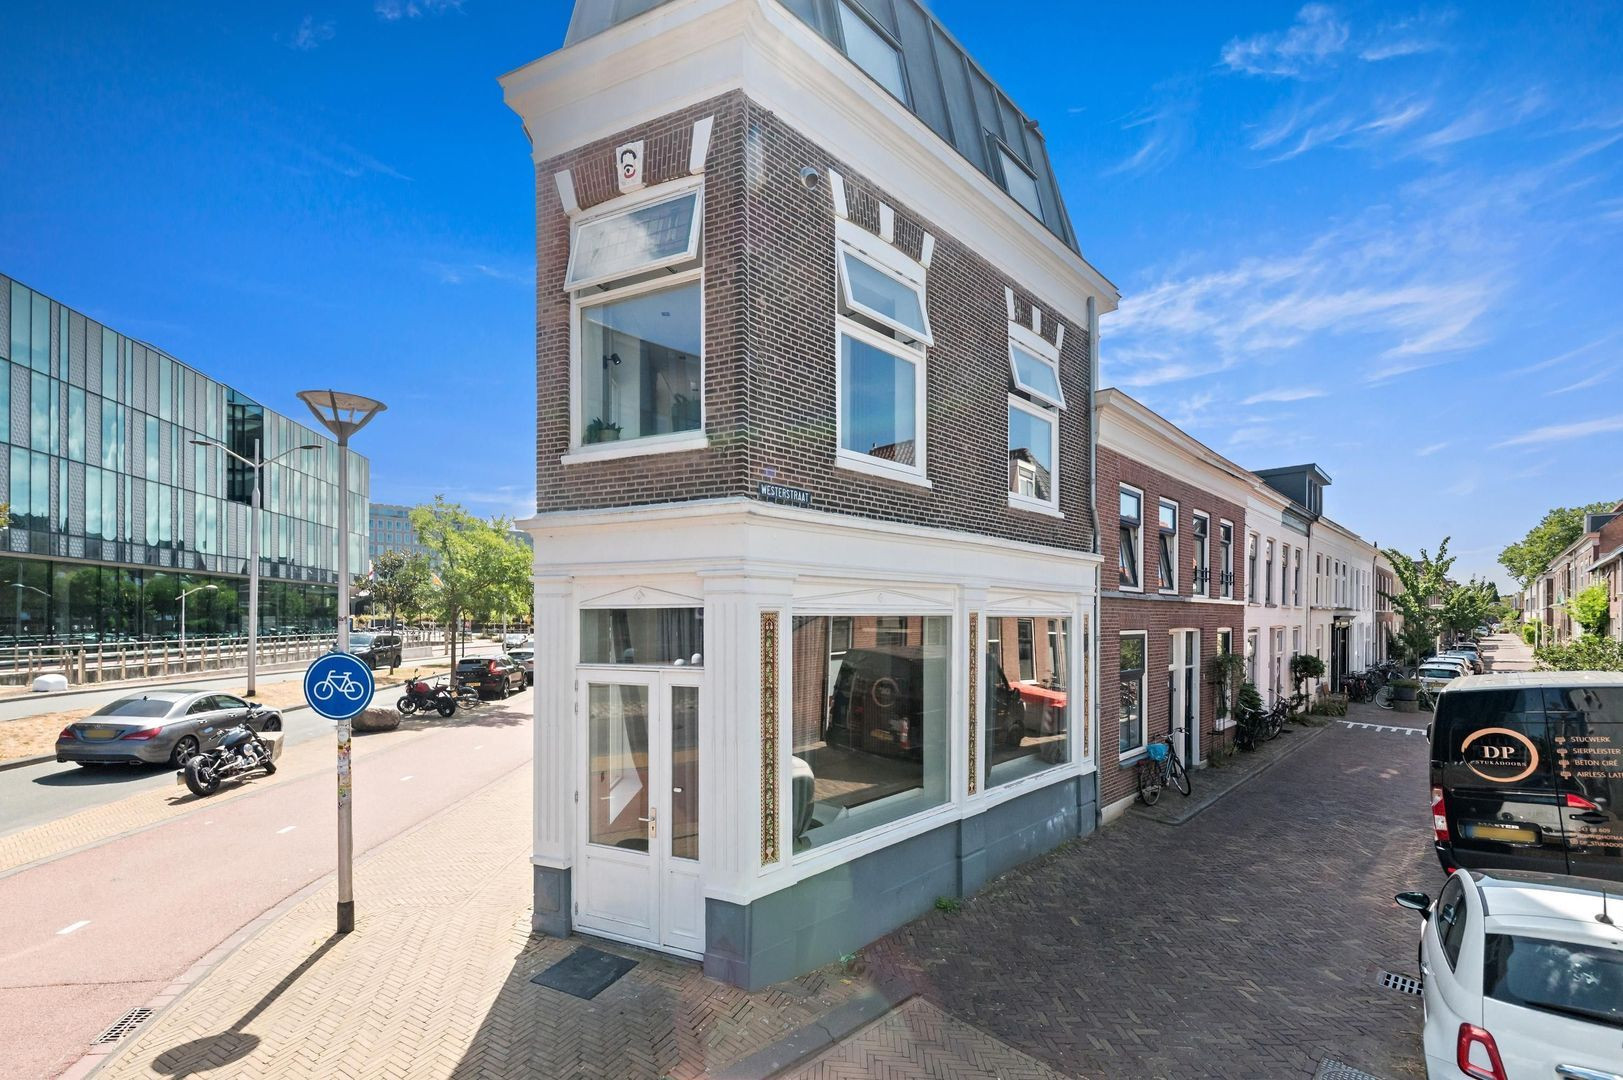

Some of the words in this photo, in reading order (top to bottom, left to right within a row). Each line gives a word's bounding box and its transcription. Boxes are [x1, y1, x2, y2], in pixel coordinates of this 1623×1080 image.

[761, 484, 808, 502] WESTERSTRAAT
[1481, 745, 1515, 759] DP
[1602, 759, 1618, 767] CIRÉ
